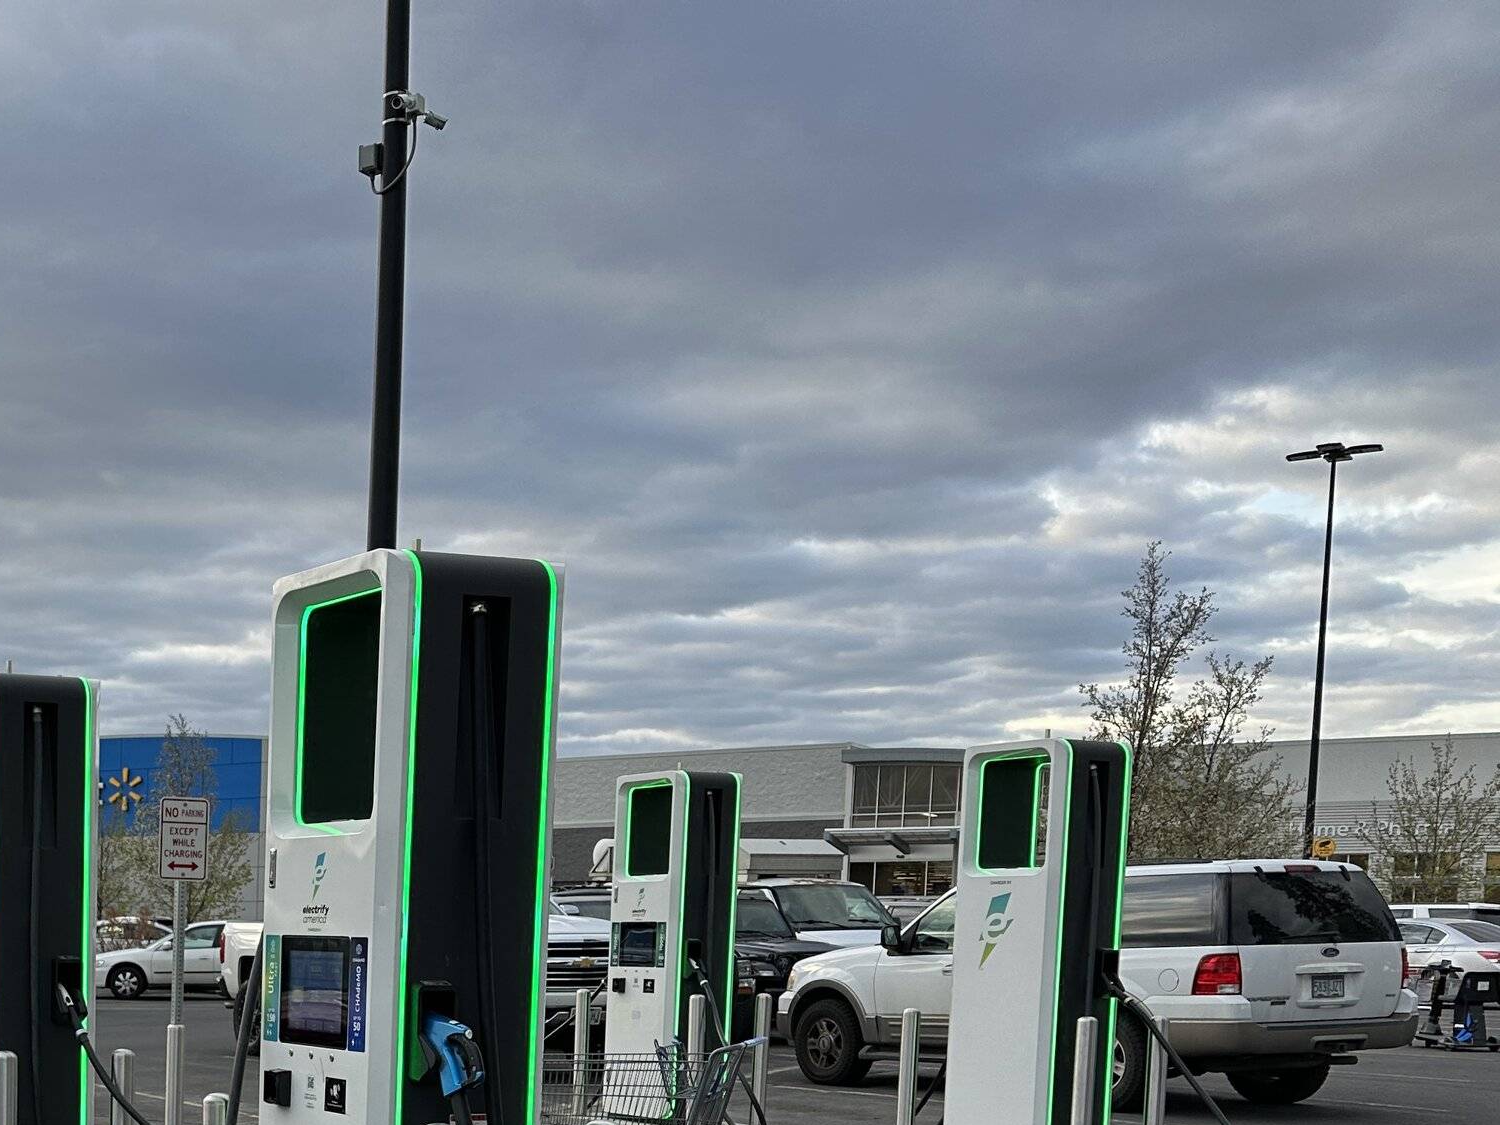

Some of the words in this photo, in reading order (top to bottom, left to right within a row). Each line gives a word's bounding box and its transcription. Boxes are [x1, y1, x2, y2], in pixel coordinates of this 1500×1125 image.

[165, 807, 179, 818] NO
[181, 810, 205, 818] PARKING
[170, 827, 198, 836] EXCEPT
[1290, 822, 1351, 837] Hme
[172, 838, 196, 847] WHILE
[164, 849, 203, 859] CHARGING
[303, 904, 329, 916] electrify
